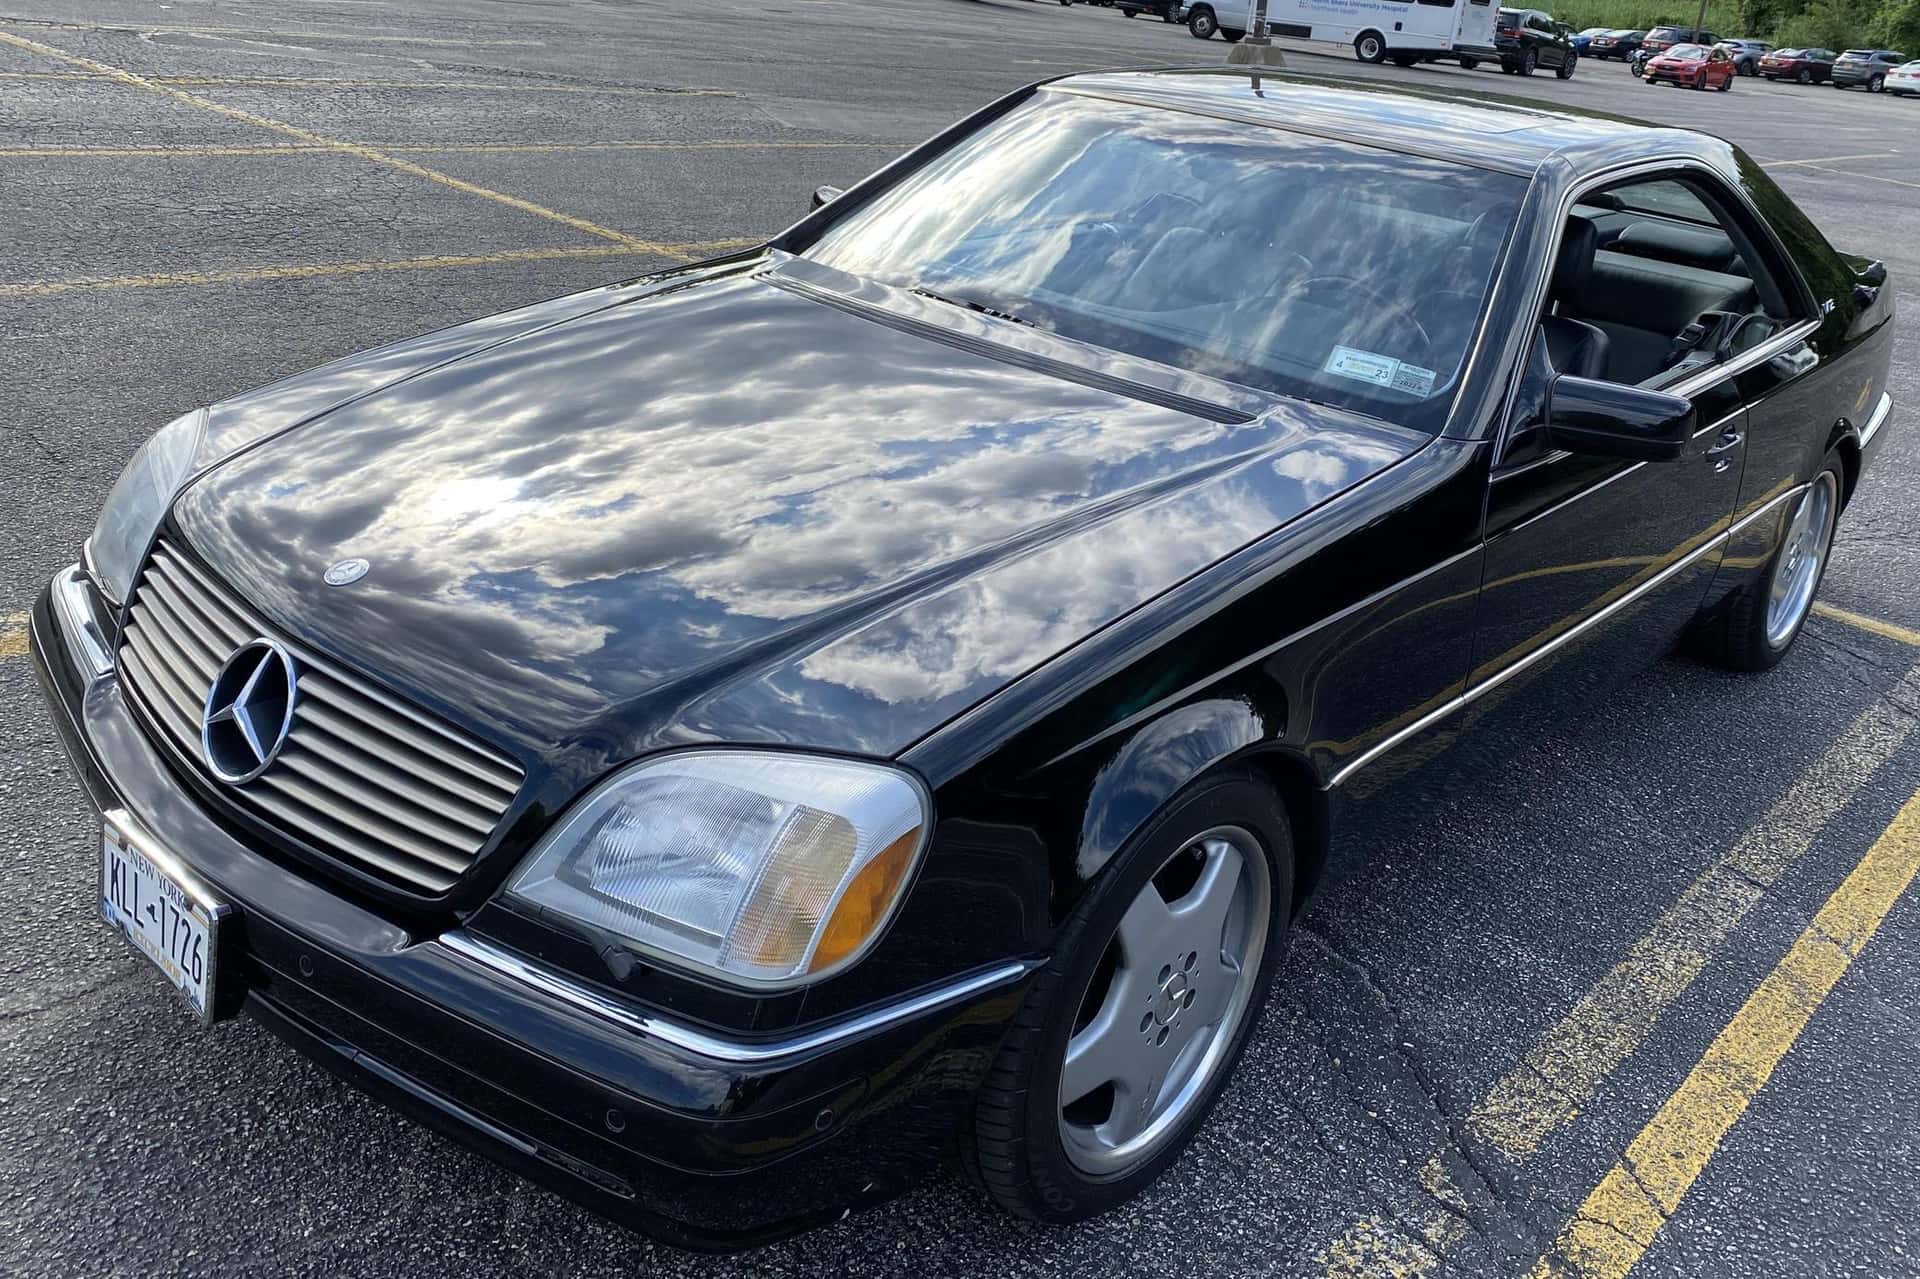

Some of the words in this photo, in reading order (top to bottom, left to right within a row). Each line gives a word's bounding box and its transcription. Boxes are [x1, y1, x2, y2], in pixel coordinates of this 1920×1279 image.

[1350, 1, 1380, 11] University
[1382, 4, 1408, 13] Hospital
[1375, 369, 1389, 379] 23
[129, 849, 155, 880] NEW
[158, 873, 186, 912] YORK
